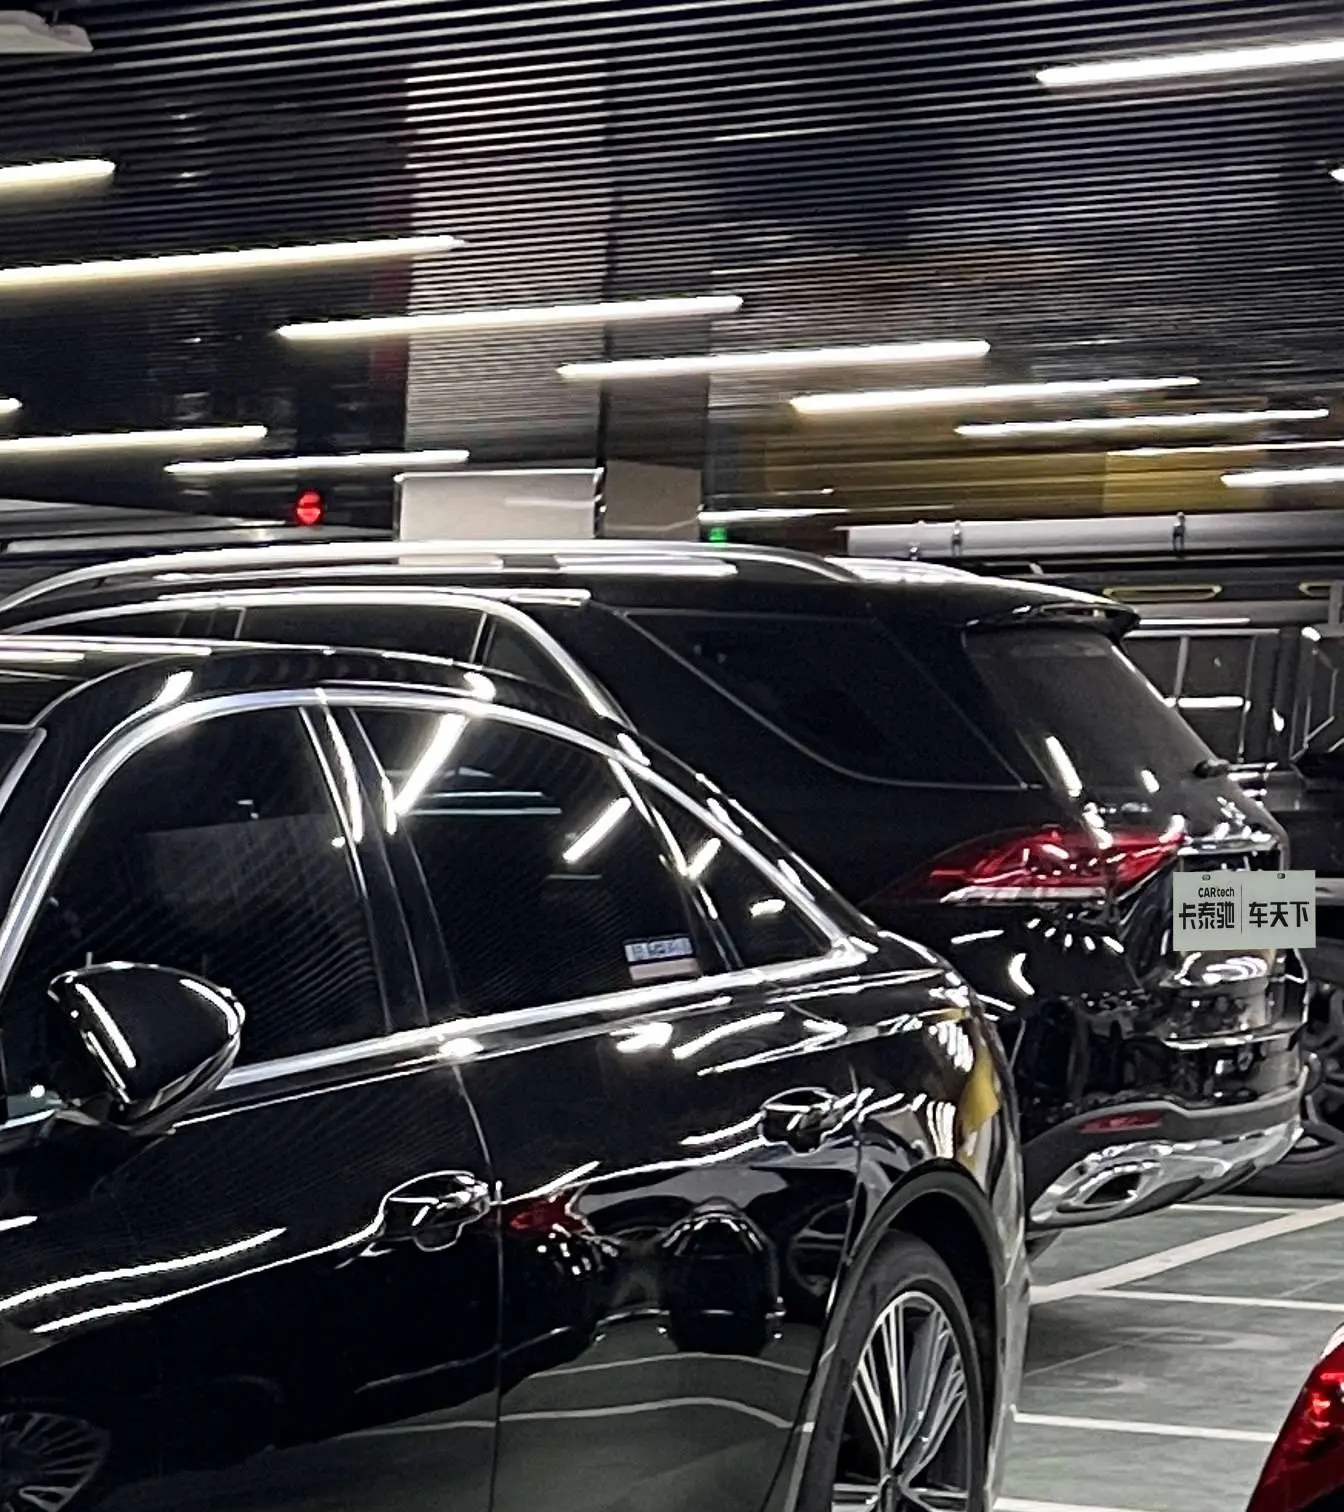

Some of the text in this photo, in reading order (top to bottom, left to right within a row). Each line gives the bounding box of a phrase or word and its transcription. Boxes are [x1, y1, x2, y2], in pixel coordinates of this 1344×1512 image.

[1197, 886, 1235, 898] CARtech
[1178, 900, 1310, 930] 卡泰驰 车天下
